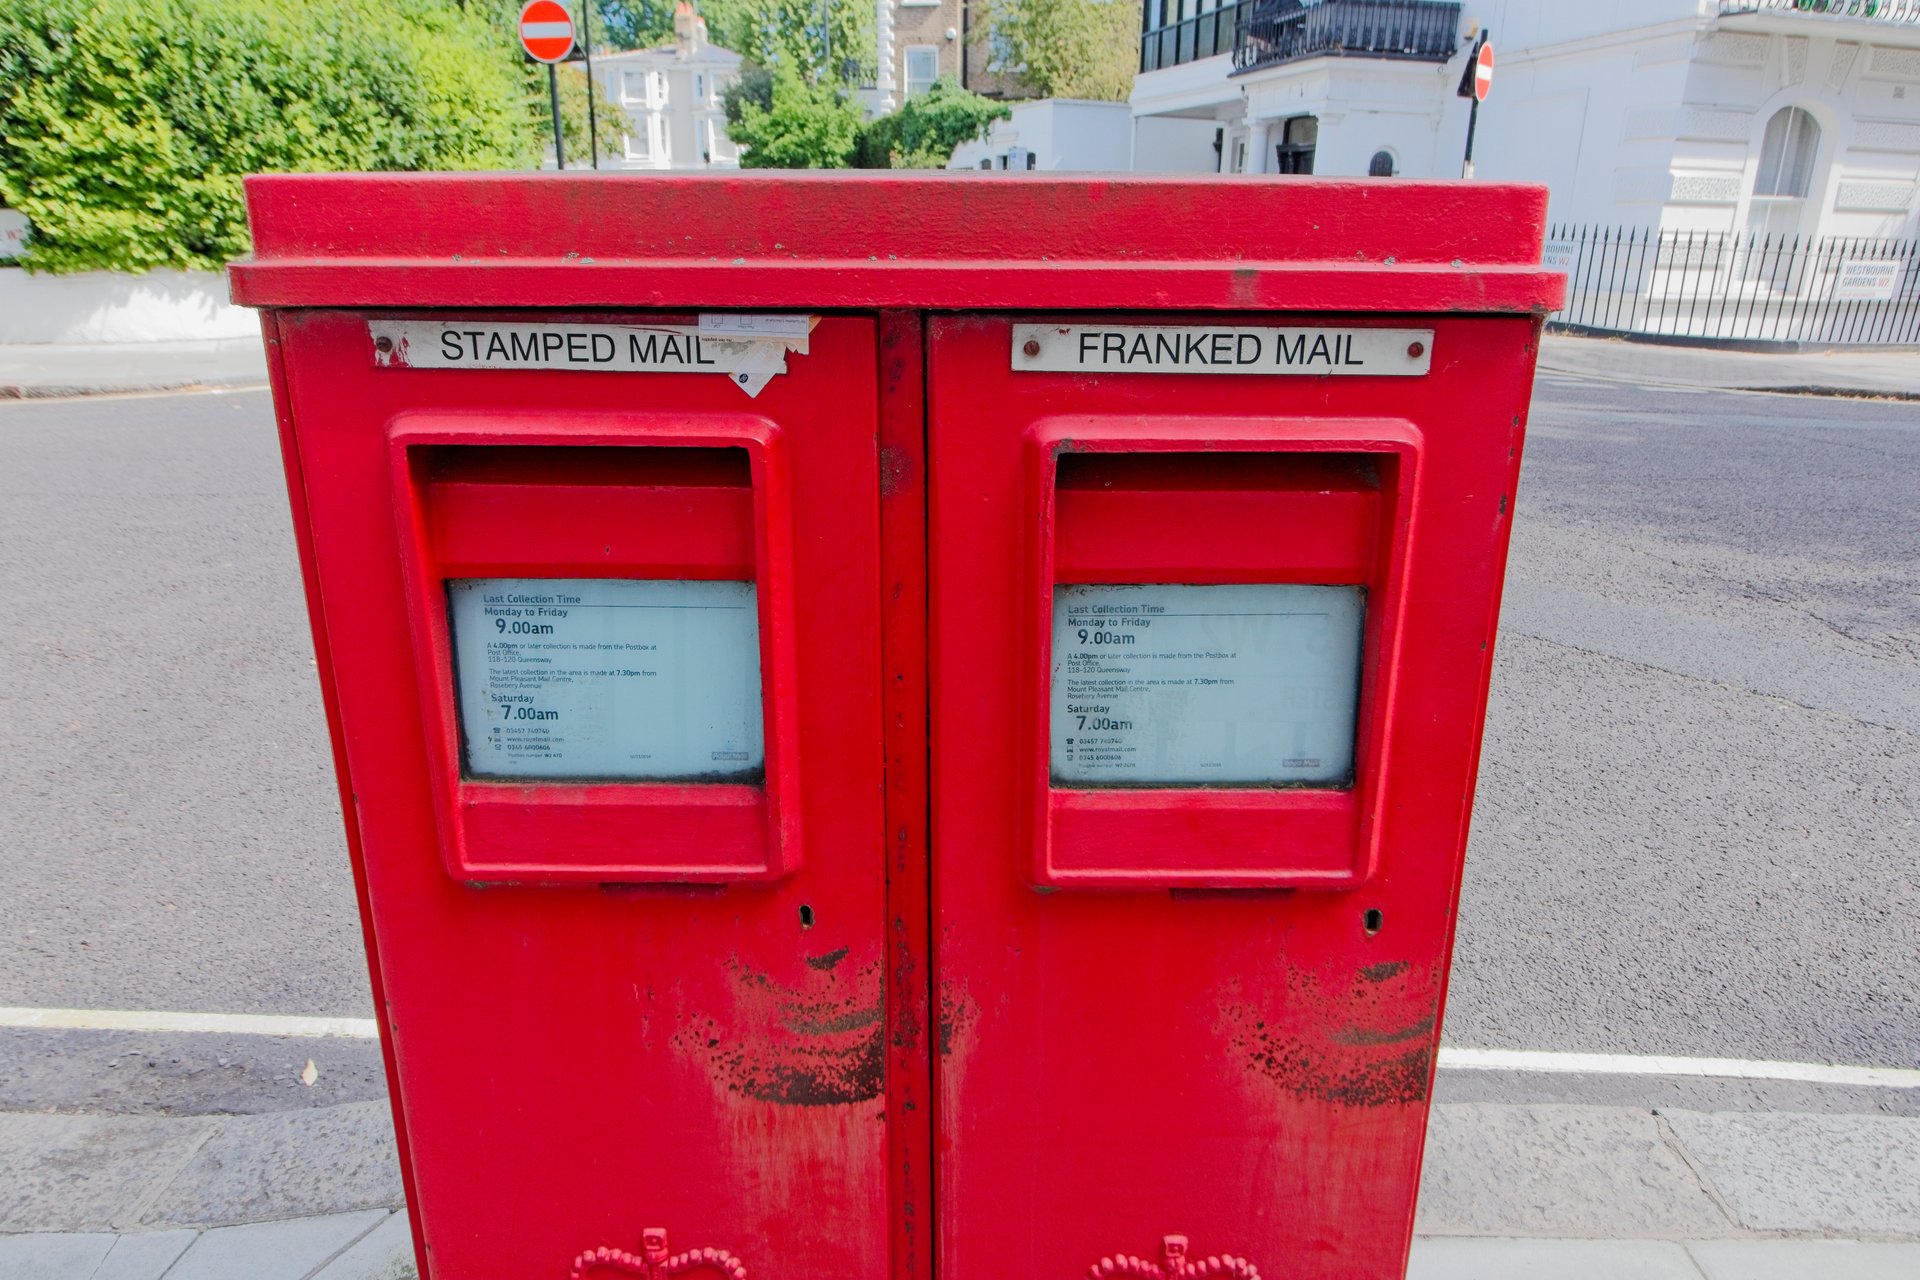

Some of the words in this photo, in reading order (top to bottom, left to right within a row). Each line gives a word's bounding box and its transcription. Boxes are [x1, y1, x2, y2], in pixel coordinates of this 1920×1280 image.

[1846, 264, 1895, 276] WESTBOURNE
[1842, 276, 1877, 288] GARDENS
[1878, 277, 1890, 289] W2
[440, 330, 616, 364] STAMPED
[629, 334, 715, 365] MAIL
[1078, 332, 1262, 366] FRANKED
[1275, 333, 1364, 366] MAIL
[483, 595, 504, 604] Last
[507, 594, 554, 604] Collection
[556, 595, 582, 604] Time
[484, 607, 522, 618] Monday
[525, 607, 535, 616] to
[538, 607, 568, 618] Friday
[1068, 605, 1089, 614] Last
[1091, 604, 1138, 614] Collection
[1141, 604, 1165, 614] Time
[495, 618, 554, 635] 9.00am
[1068, 618, 1105, 628] Monday
[1108, 618, 1118, 626] to
[1121, 617, 1151, 628] Friday
[1077, 629, 1135, 645] 9.00am
[493, 642, 518, 651] 4.00pm
[527, 642, 542, 650] later
[625, 643, 649, 651] Postbox
[517, 656, 552, 664] Queensway
[1073, 652, 1098, 661] 4.00pm
[616, 669, 641, 678] 7.30pm
[1067, 666, 1096, 674] 118-120
[1096, 666, 1131, 674] Queensway
[490, 682, 518, 690] Rosebery
[1194, 678, 1218, 686] 7.30pm
[491, 693, 535, 705] Saturday
[501, 704, 559, 720] 7.00am
[1067, 704, 1110, 714] Saturday
[1076, 715, 1133, 731] 7.00am
